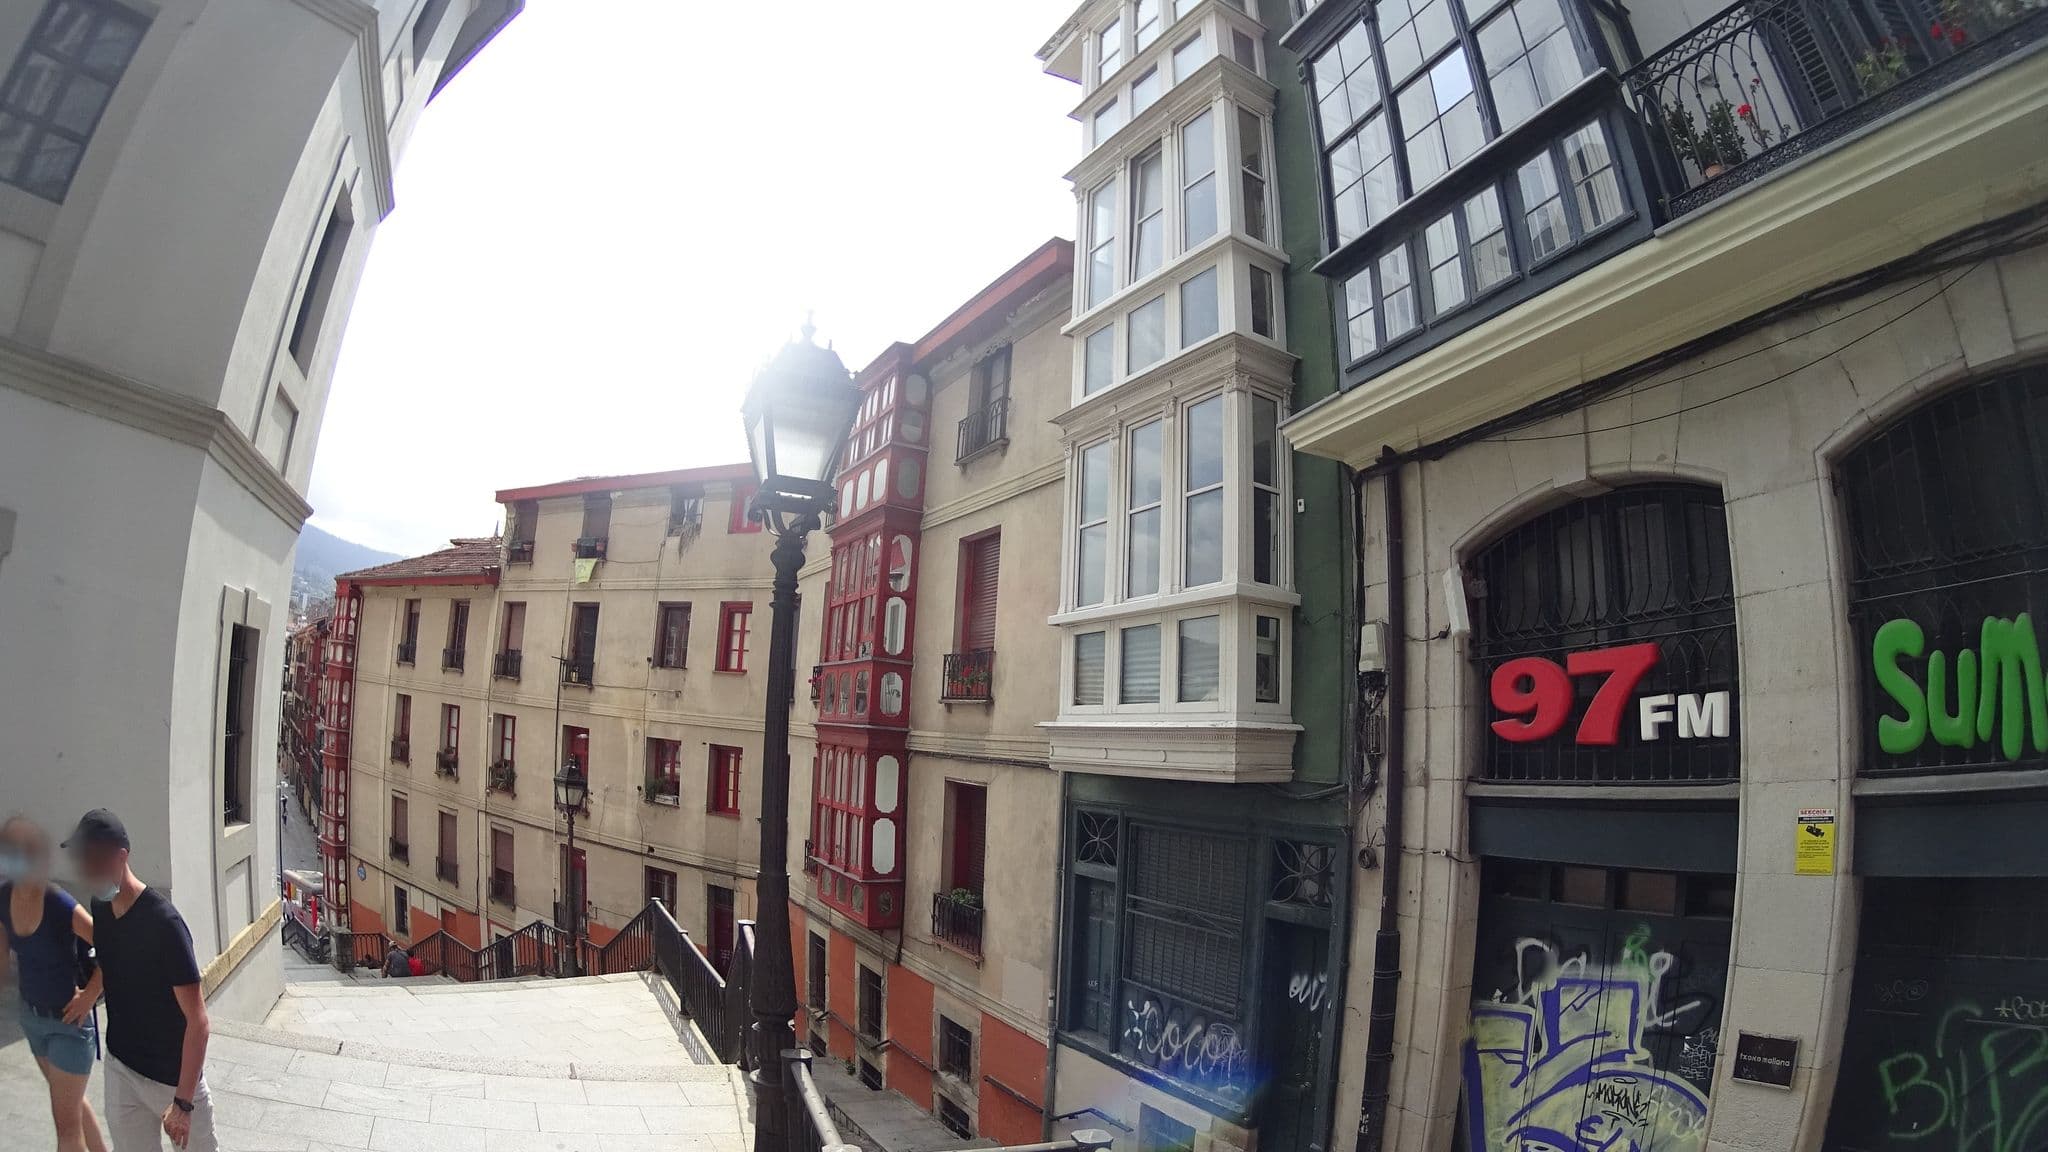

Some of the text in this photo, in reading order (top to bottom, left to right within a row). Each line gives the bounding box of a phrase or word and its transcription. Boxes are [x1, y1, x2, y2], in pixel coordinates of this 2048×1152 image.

[1490, 643, 1730, 745] 97 FM
[1873, 612, 2048, 761] SuM
